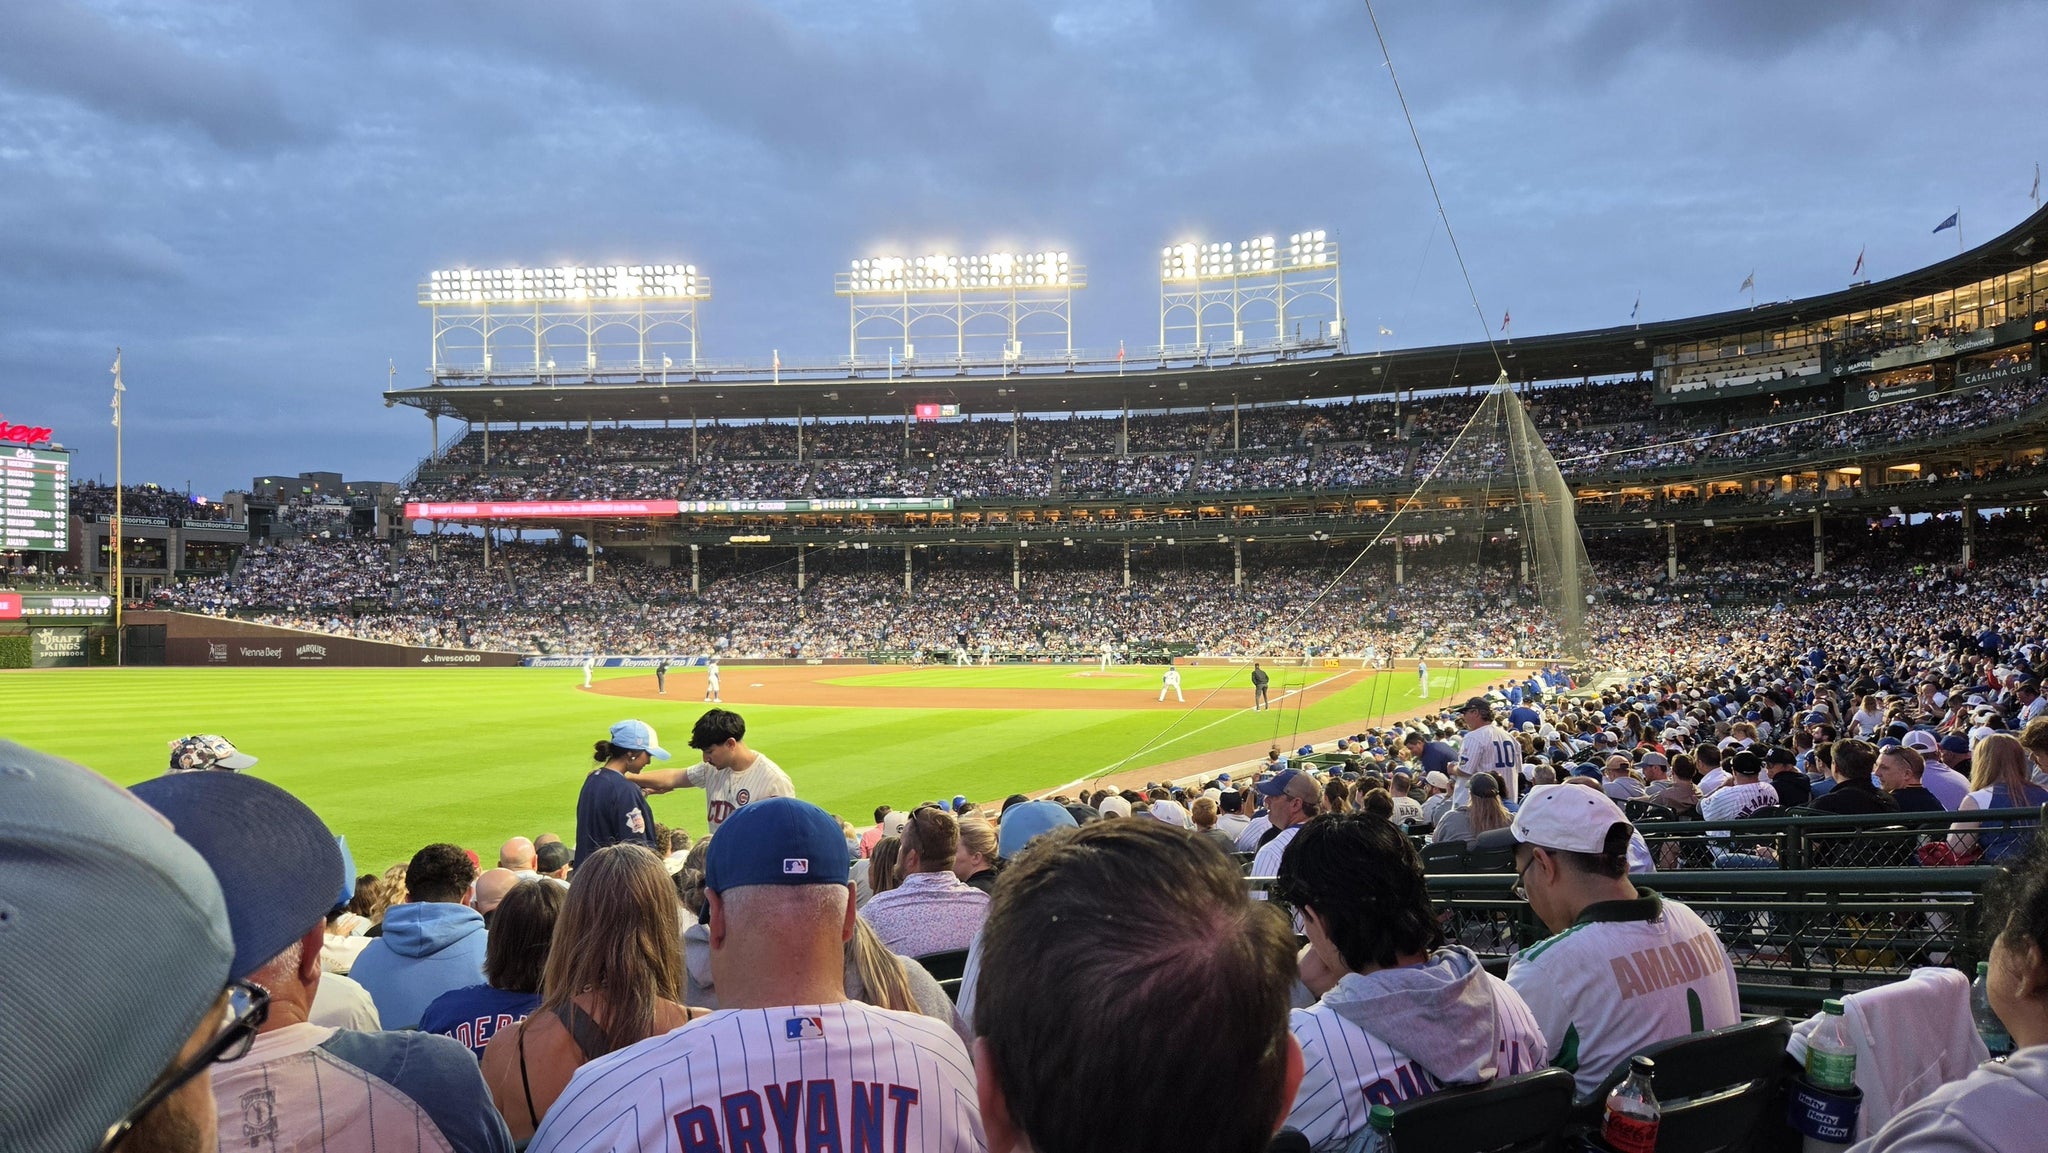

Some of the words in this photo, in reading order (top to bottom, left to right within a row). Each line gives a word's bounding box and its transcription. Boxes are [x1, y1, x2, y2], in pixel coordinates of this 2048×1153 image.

[1965, 370, 2008, 384] CATALINA
[2011, 363, 2033, 375] CLUB
[40, 635, 82, 645] DRAFT
[45, 643, 80, 651] KINGS
[240, 647, 264, 657] Vienna
[265, 647, 283, 659] Beef
[296, 644, 327, 656] MARQUEE
[532, 658, 569, 667] Reynolds
[621, 659, 661, 667] Reynolds
[1493, 741, 1515, 767] 10
[1400, 806, 1419, 816] HAPP
[673, 1079, 919, 1153] BRYANT
[1808, 1109, 1839, 1125] Hefty
[1818, 1125, 1848, 1137] Hefty
